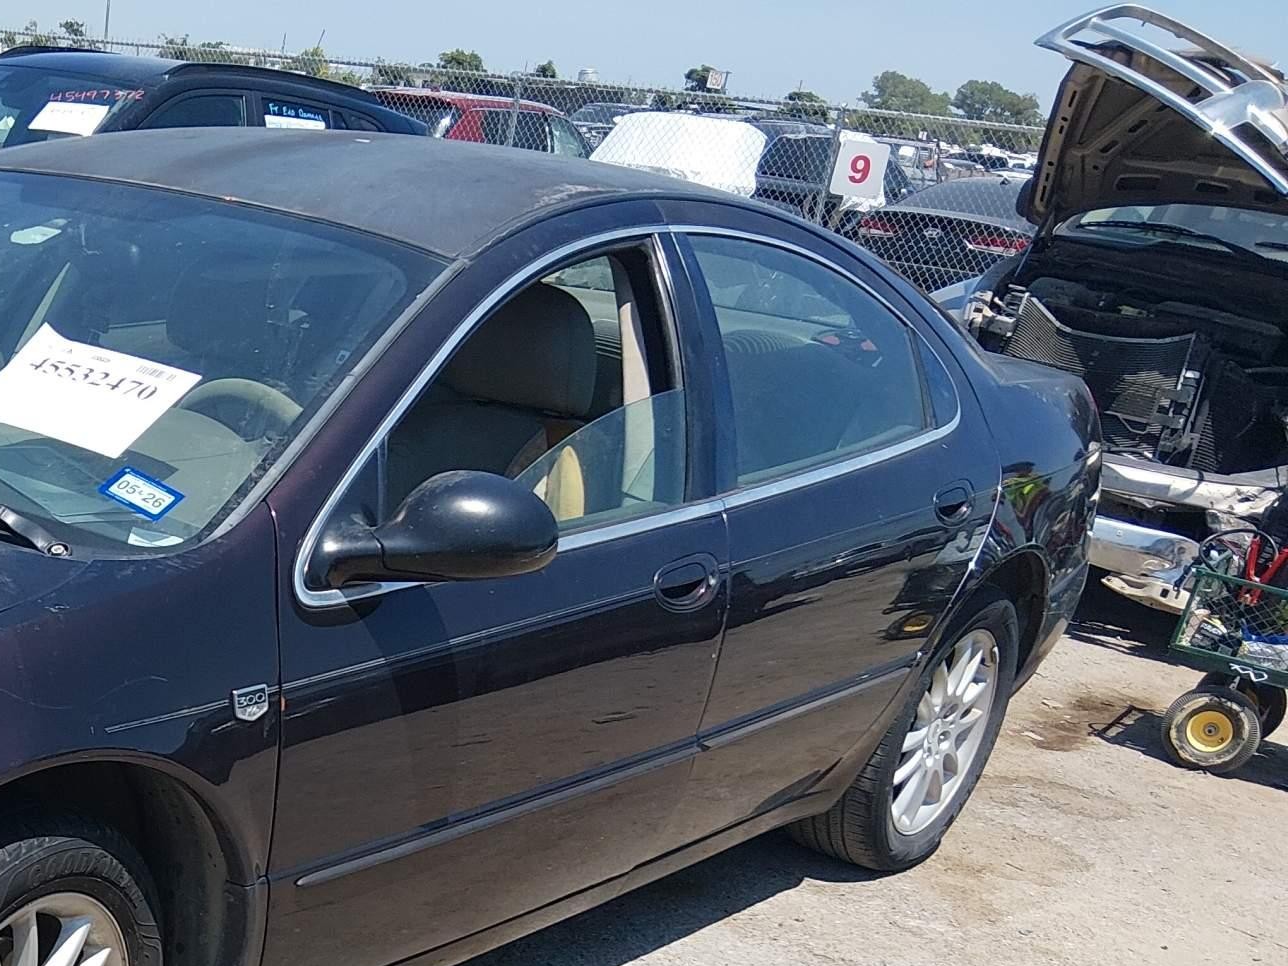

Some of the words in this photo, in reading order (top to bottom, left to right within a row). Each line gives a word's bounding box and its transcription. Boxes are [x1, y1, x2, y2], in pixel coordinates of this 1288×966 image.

[848, 154, 872, 184] 9
[29, 358, 158, 401] 45532470
[237, 693, 265, 707] 300
